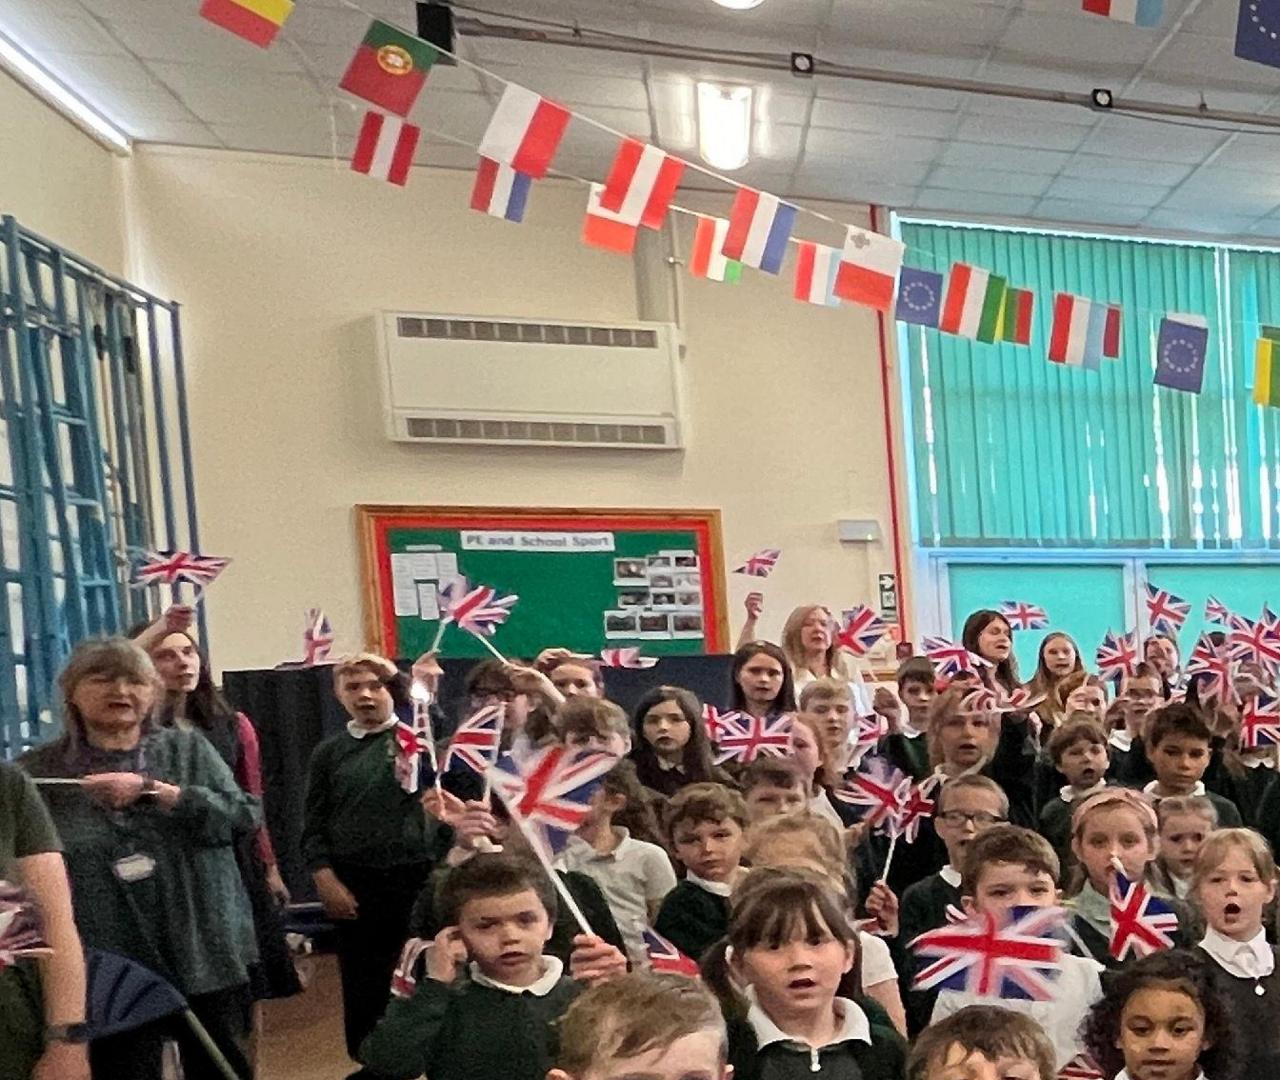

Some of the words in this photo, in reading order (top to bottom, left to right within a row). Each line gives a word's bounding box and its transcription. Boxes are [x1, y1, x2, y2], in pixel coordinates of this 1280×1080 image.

[488, 535, 514, 546] and
[521, 535, 567, 547] School
[572, 536, 609, 548] Sport
